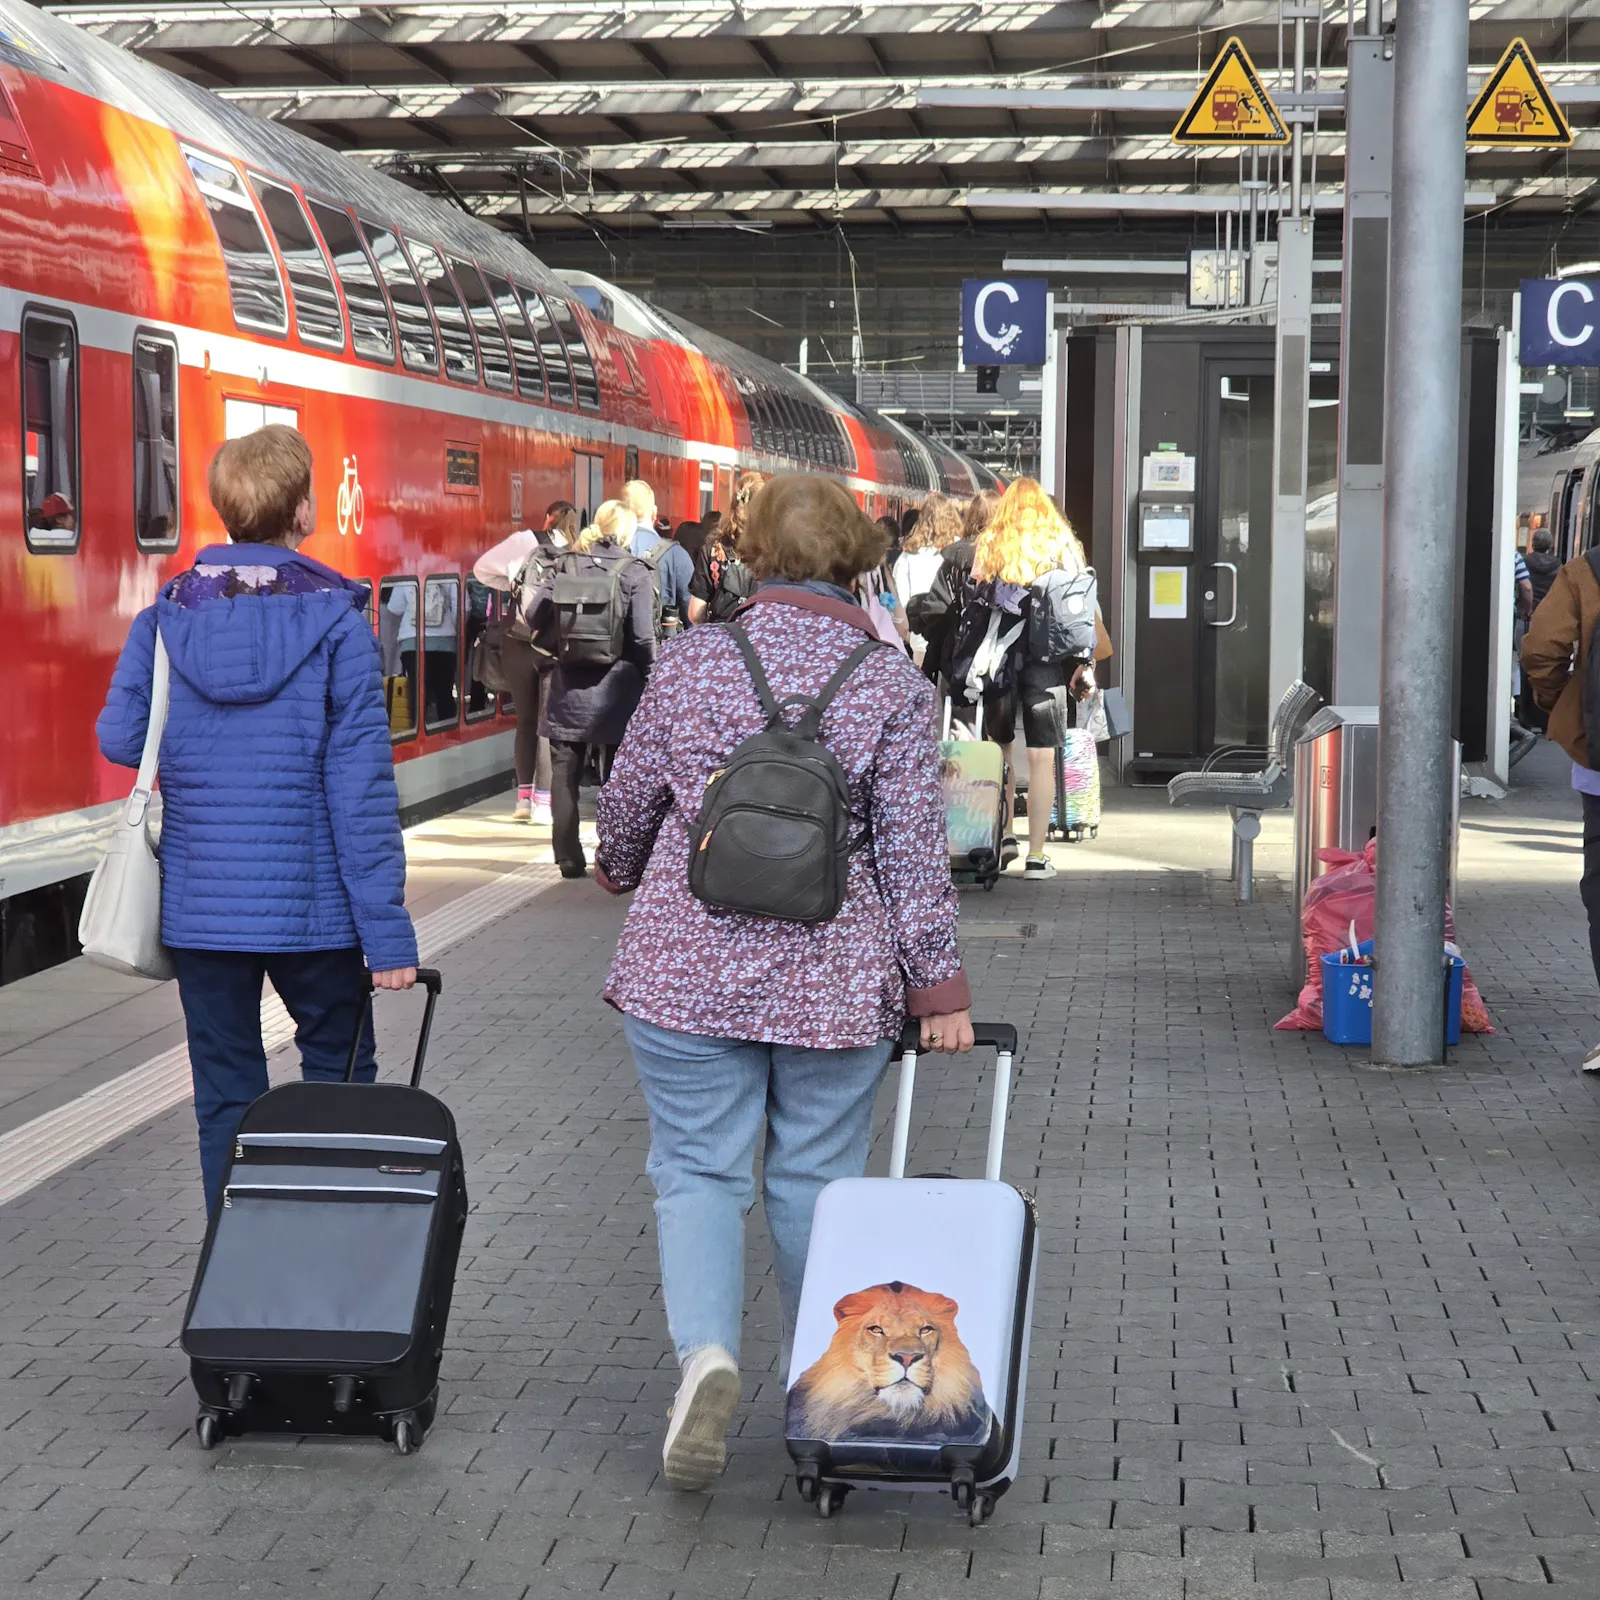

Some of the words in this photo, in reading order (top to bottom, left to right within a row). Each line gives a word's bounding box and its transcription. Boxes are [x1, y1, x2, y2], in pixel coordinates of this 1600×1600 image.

[974, 282, 1020, 348] C
[1547, 282, 1594, 347] C
[1321, 768, 1332, 786] DB
